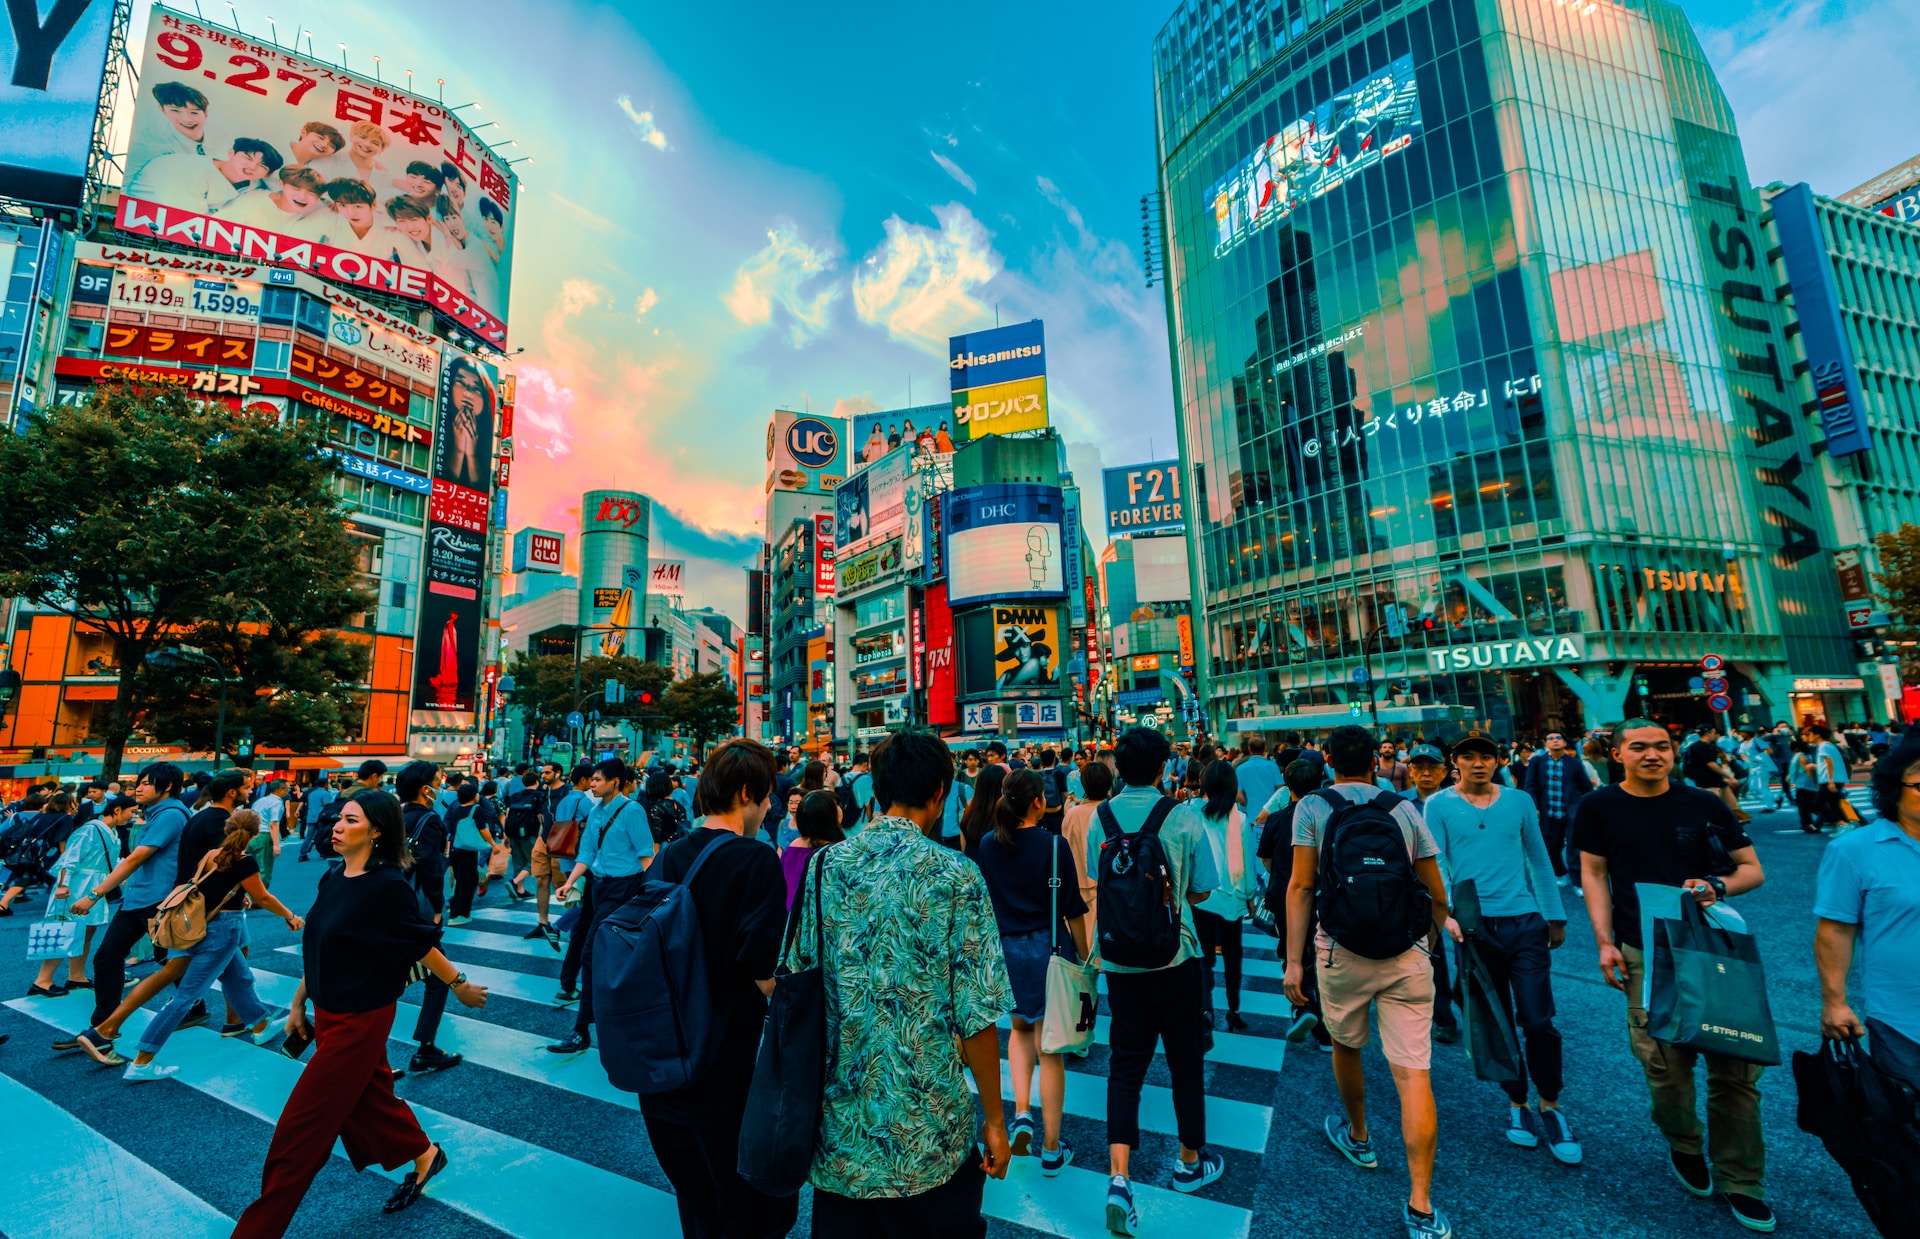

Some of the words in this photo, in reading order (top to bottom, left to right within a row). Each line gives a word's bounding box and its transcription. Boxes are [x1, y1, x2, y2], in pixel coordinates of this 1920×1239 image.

[156, 31, 317, 106] 9.27
[335, 89, 511, 212] 日本上陸
[1896, 188, 1920, 222] B
[101, 246, 257, 278] しゃぶしゃぶバイキング
[79, 275, 109, 293] 9F
[117, 283, 184, 307] 1,199円
[192, 291, 259, 315] 1,599円
[323, 284, 438, 345] しゃぶしゃぶバイキング
[433, 281, 505, 338] ワナワン
[109, 327, 249, 361] プライス
[368, 330, 433, 374] しゃぶ葉
[950, 344, 1042, 370] Hisamitsu
[192, 370, 261, 395] ガスト
[292, 349, 405, 406] コンタクト
[1699, 175, 1822, 567] TSUTAYA
[954, 393, 1042, 425] サロンパス
[1814, 360, 1856, 439] SEIBU
[372, 413, 423, 442] ガスト
[792, 428, 834, 456] UC
[433, 483, 488, 506] ユリゴコロ
[1128, 465, 1180, 505] F21
[593, 501, 641, 529] 109
[981, 503, 1017, 519] DHC
[1110, 502, 1183, 528] FOREVER
[431, 526, 482, 552] Rihwa
[905, 485, 923, 566] もんじゃ
[1065, 504, 1078, 547] Taisei
[432, 547, 454, 561] 9.20
[534, 534, 556, 550] UNI
[534, 548, 558, 562] QLO
[652, 563, 681, 581] H&M
[1070, 551, 1079, 590] neon
[996, 608, 1047, 625] DMM
[997, 625, 1031, 643] FX
[1087, 629, 1098, 660] 三千里
[858, 648, 892, 663] Euphoria
[1432, 636, 1582, 671] TSUTAYA
[1018, 704, 1057, 723] 書店
[1701, 1023, 1739, 1038] G-STAR
[1740, 1031, 1763, 1043] RAW
